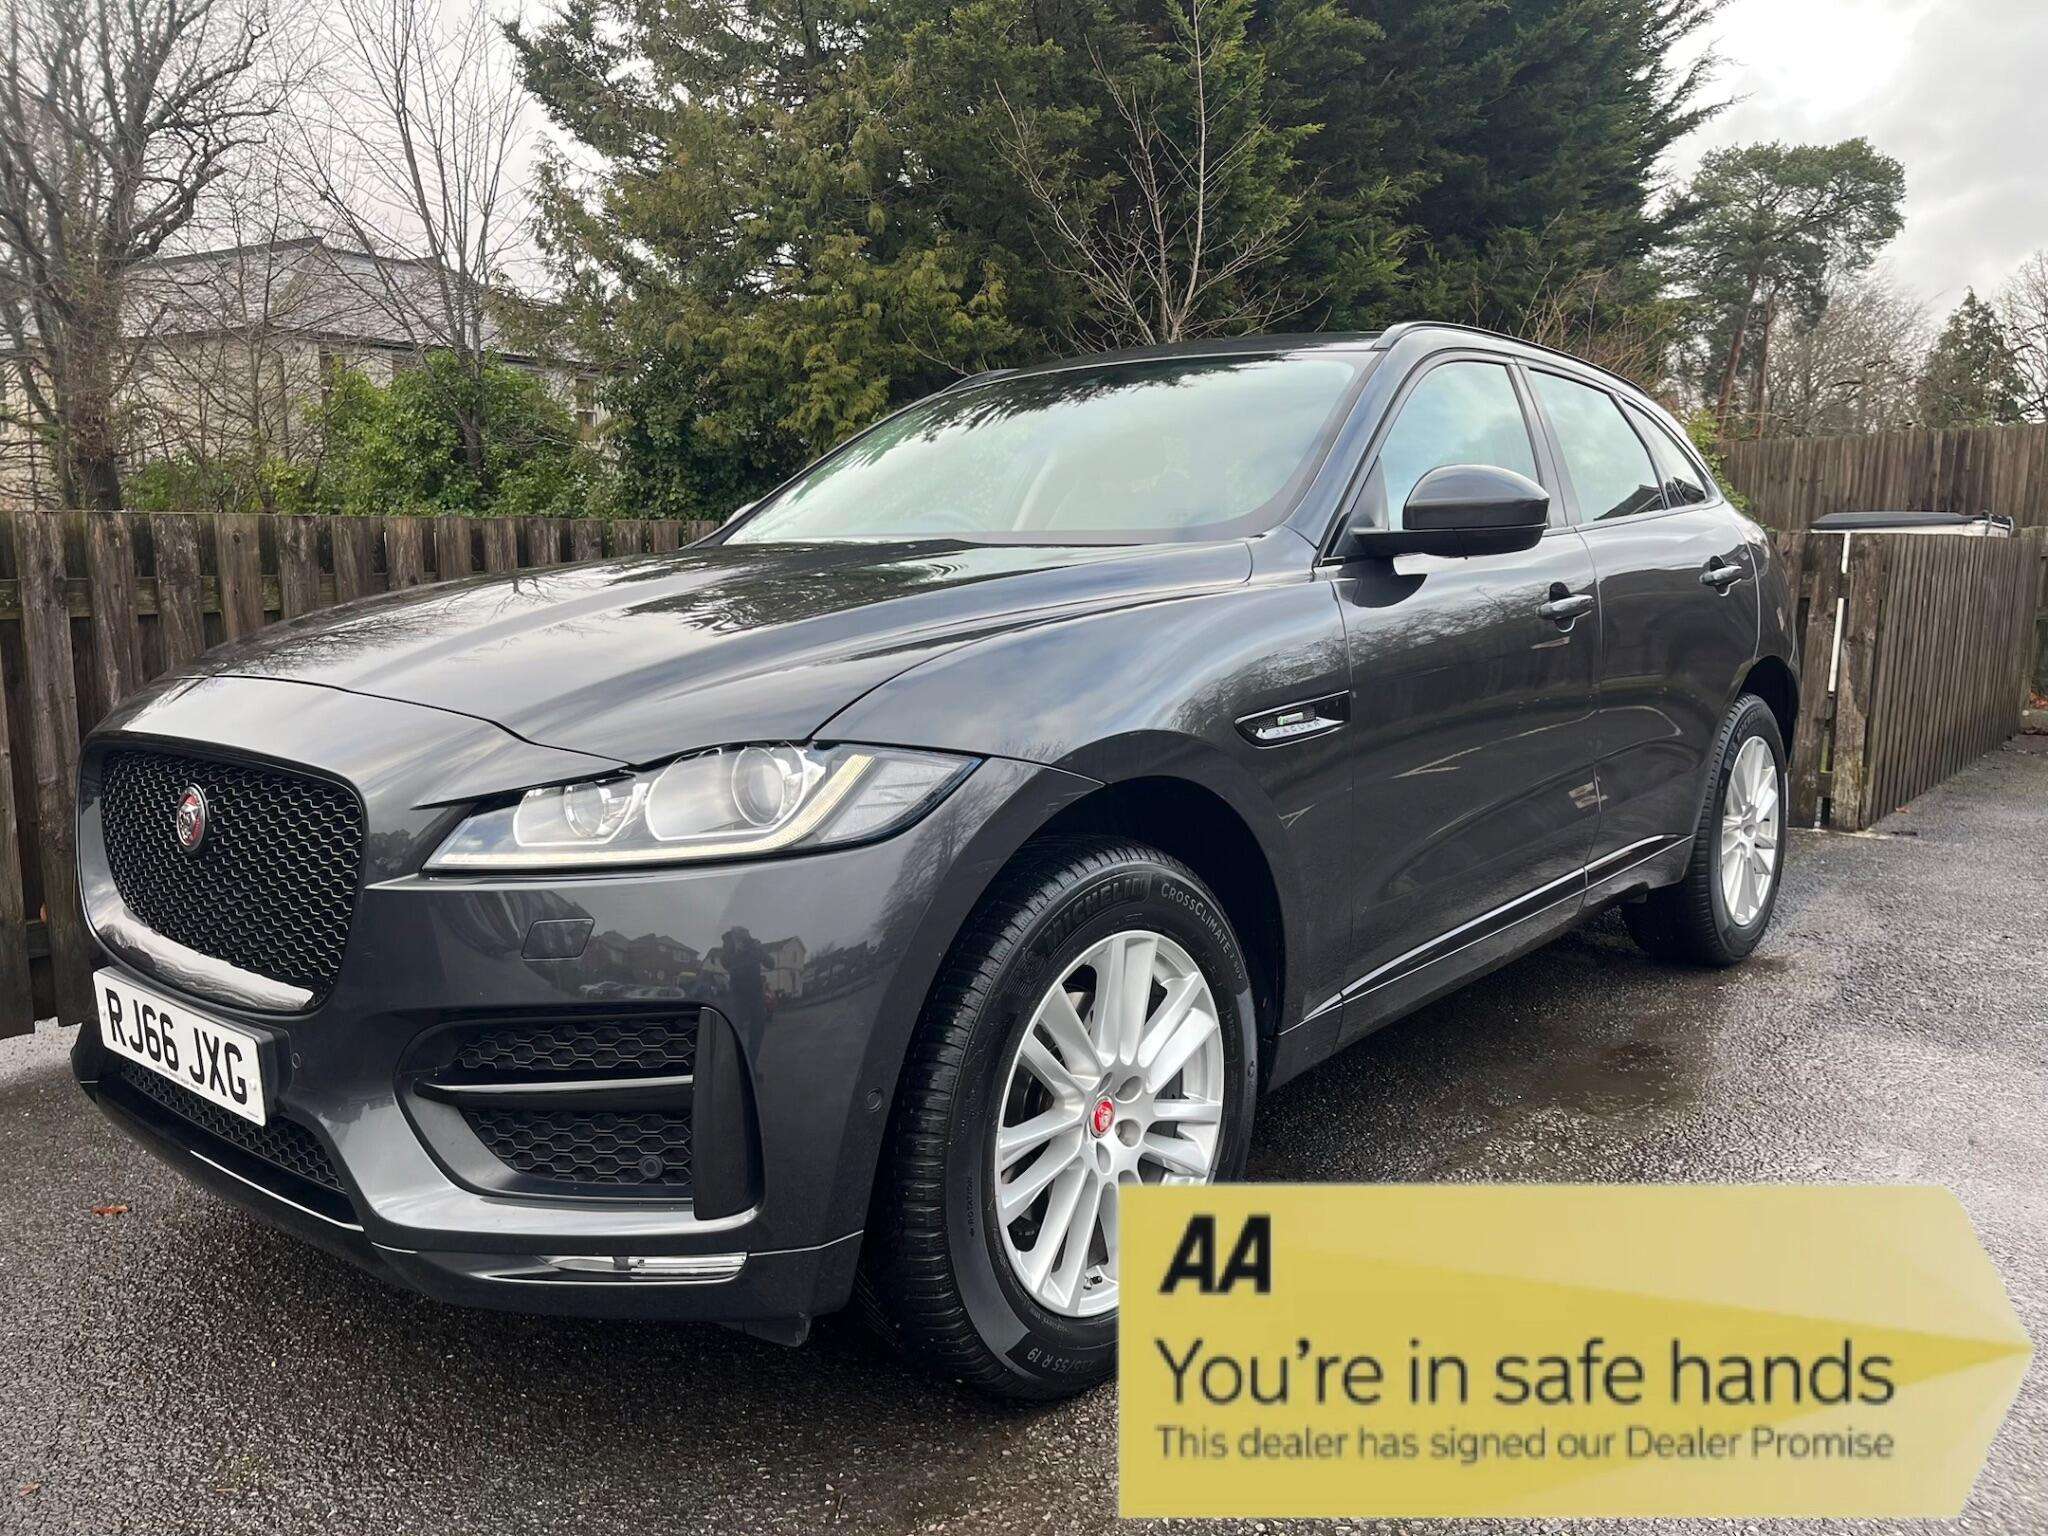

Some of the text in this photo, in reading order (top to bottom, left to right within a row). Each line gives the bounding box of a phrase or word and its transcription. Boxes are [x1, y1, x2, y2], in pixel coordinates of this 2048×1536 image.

[1160, 881, 1231, 955] CROSSCLIMATE
[105, 987, 248, 1105] RJ66 JXG
[1027, 1347, 1042, 1363] 19
